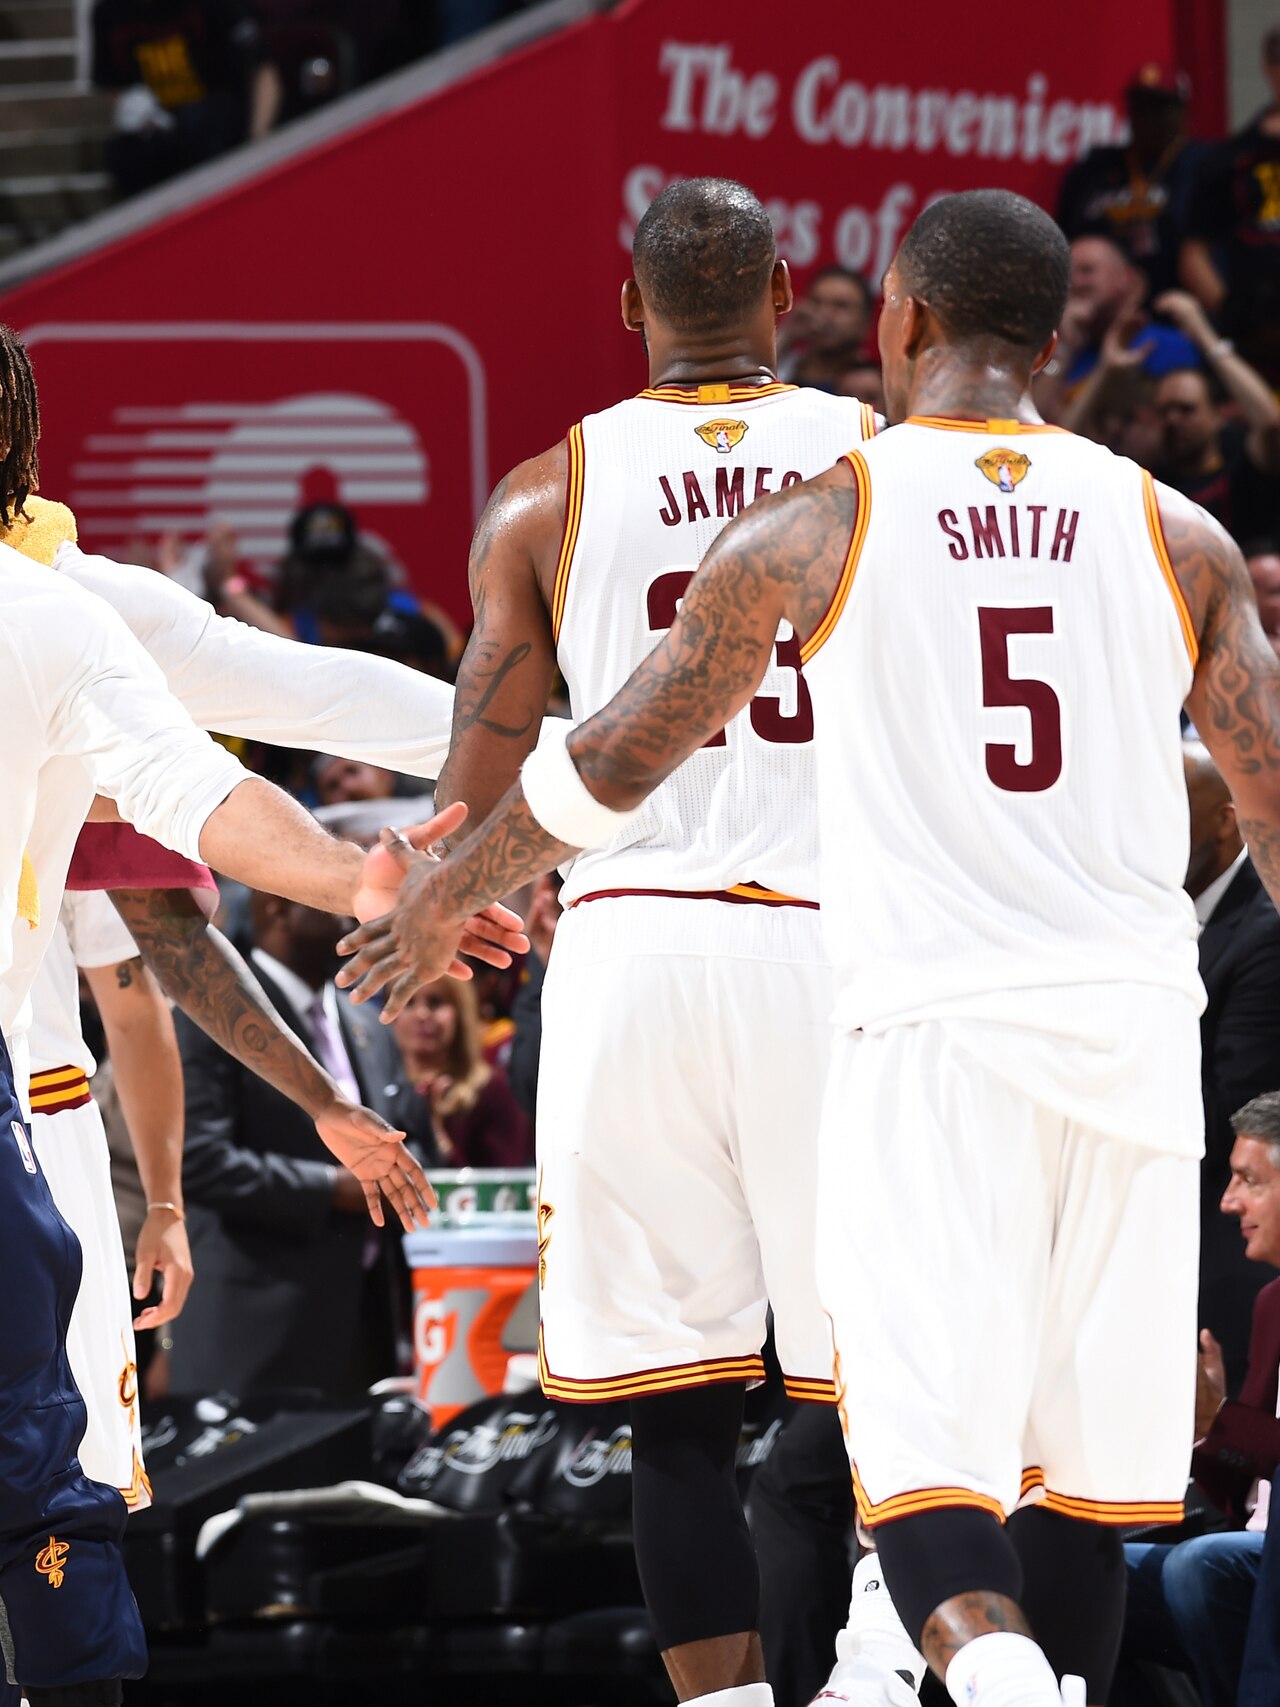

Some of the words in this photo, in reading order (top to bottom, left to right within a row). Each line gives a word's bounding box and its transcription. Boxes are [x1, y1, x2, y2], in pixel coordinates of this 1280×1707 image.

[659, 40, 780, 139] The
[833, 182, 913, 294] of
[938, 505, 1080, 563] SMITH
[977, 606, 1063, 793] 5
